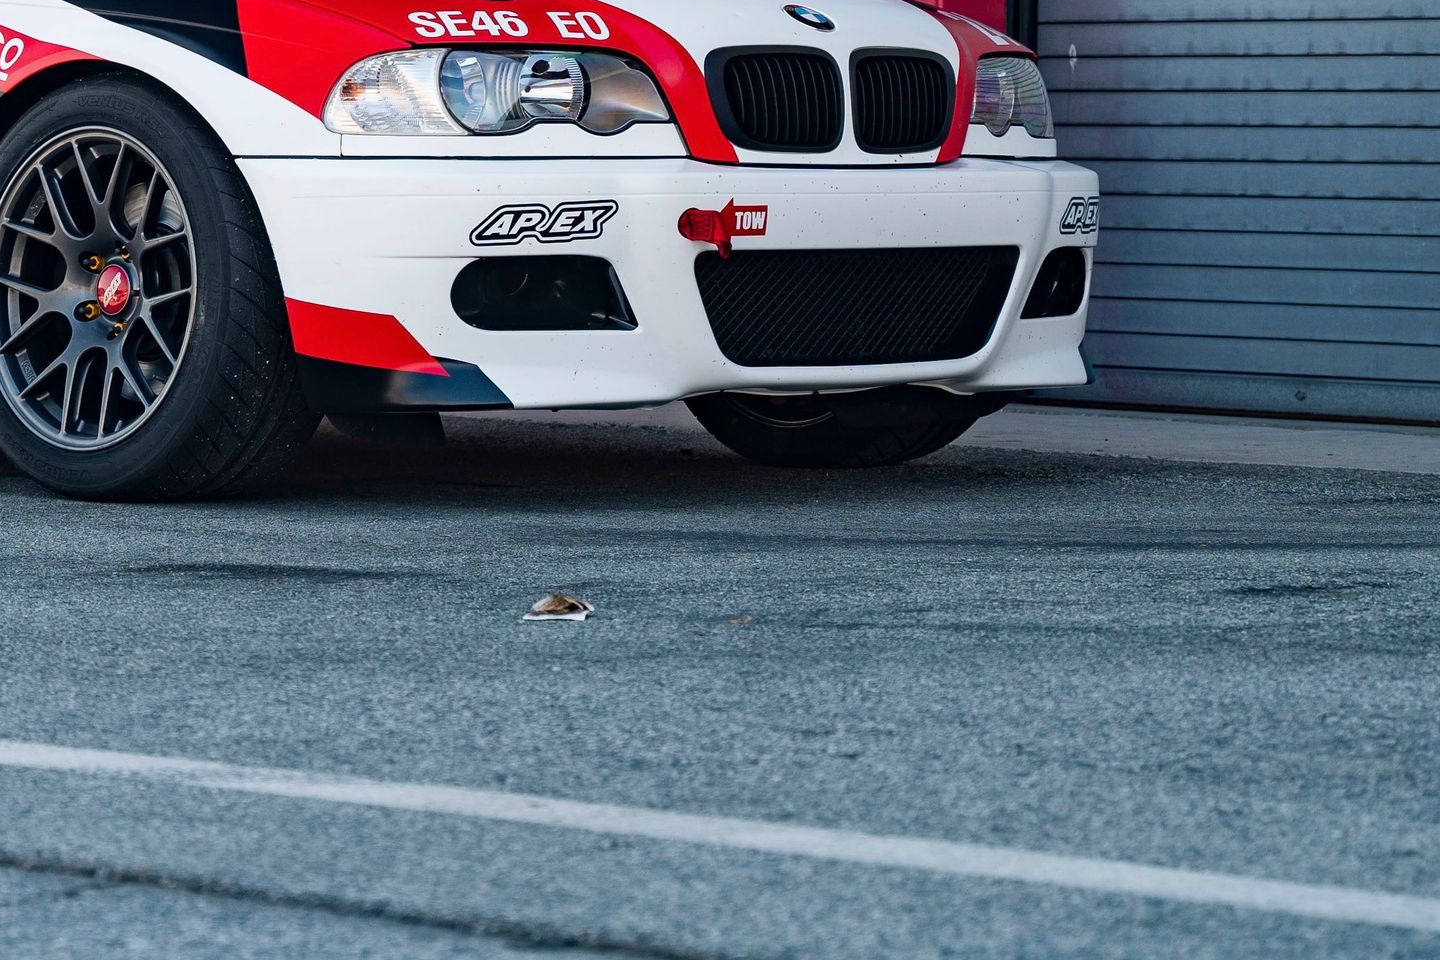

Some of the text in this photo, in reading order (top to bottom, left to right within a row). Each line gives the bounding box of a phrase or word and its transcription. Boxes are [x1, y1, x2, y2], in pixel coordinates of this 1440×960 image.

[407, 10, 529, 38] SE46
[479, 207, 609, 239] APEX
[734, 211, 767, 231] TOW
